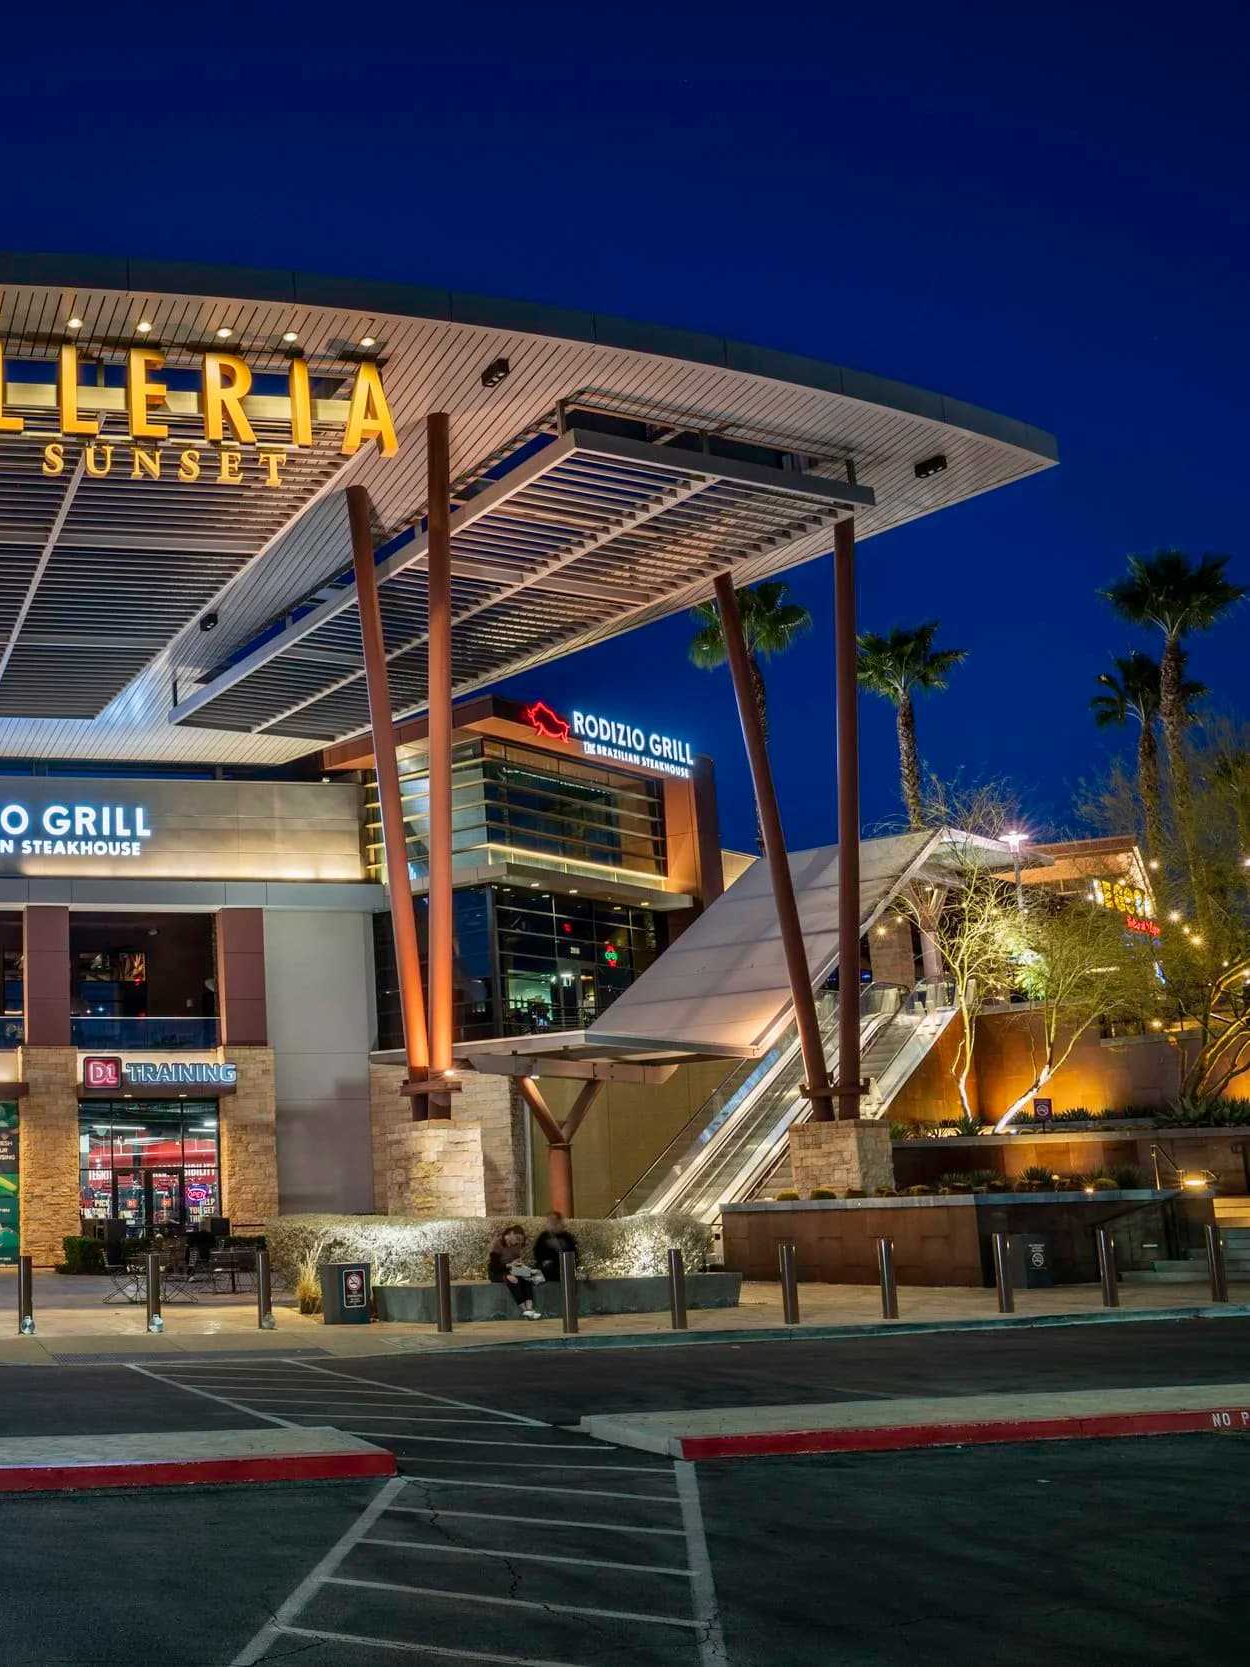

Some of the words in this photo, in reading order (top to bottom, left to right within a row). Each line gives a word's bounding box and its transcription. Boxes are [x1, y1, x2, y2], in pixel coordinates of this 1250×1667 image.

[42, 443, 287, 487] SUNSET
[573, 711, 646, 751] RODIZIO
[649, 733, 694, 766] GRILL
[597, 746, 641, 765] BRAZILIAN
[642, 756, 690, 779] STEAKHOUSE
[43, 805, 151, 837] GRILL
[22, 838, 141, 857] STEAKHOUSE
[88, 1060, 119, 1085] D1
[126, 1062, 238, 1085] TRAINING
[1211, 1412, 1231, 1428] NO
